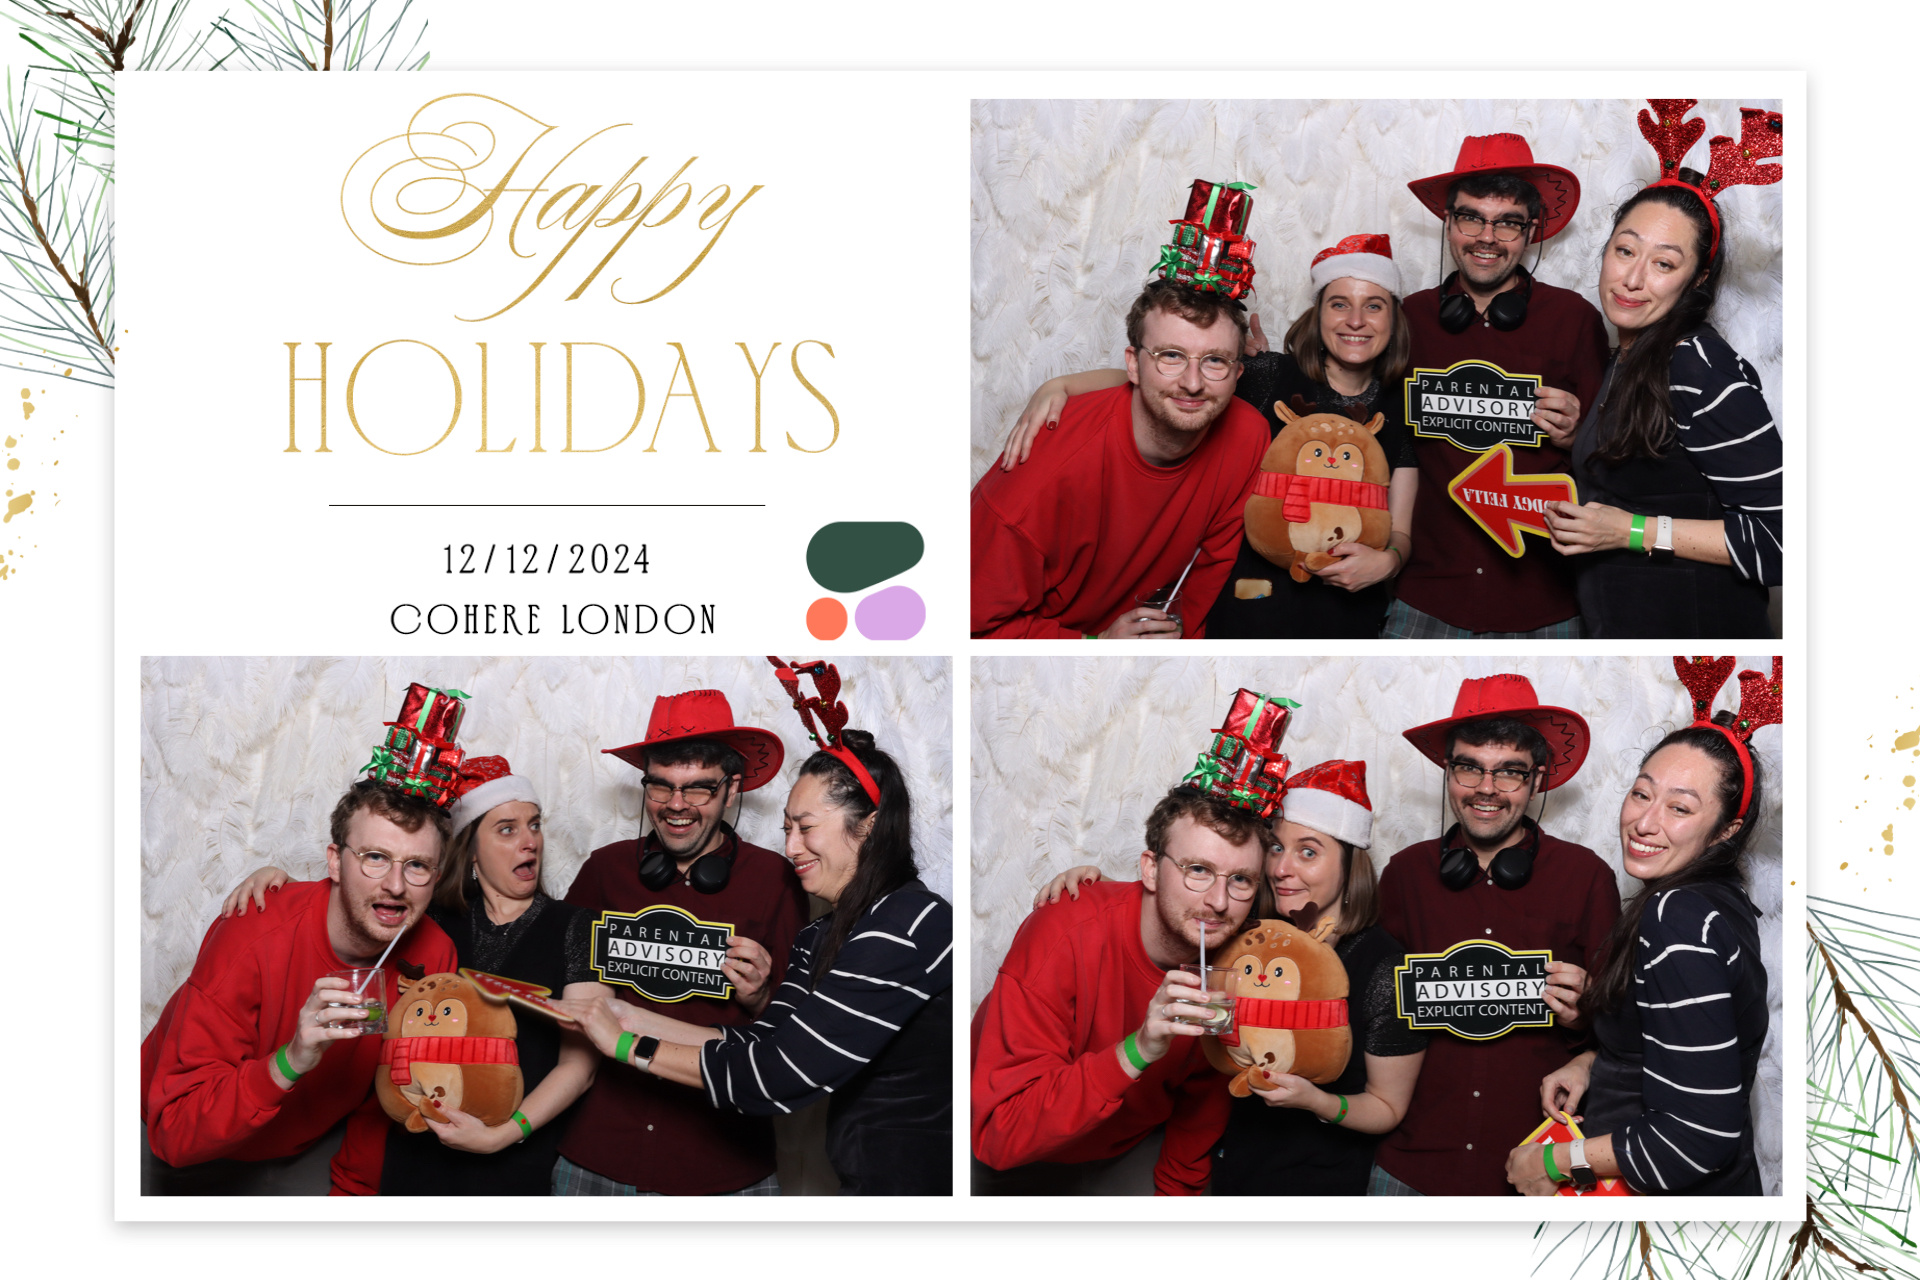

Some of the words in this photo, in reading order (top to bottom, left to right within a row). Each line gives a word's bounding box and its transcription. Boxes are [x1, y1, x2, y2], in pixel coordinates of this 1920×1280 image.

[1421, 379, 1534, 398] PARENTAL
[1422, 396, 1534, 417] ADVISORY
[1422, 416, 1472, 430] EXPLICIT
[1474, 420, 1534, 435] CONTENT
[1462, 488, 1508, 508] FELLA
[610, 923, 725, 947] PARENTAL
[609, 940, 724, 967] ADVISORY
[608, 961, 659, 977] EXPLICIT
[662, 968, 723, 986] CONTENT
[1415, 963, 1544, 978] PARENTAL
[1417, 981, 1544, 999] ADVISORY
[1418, 1005, 1475, 1017] EXPLICIT
[1479, 1003, 1545, 1016] CONTENT
